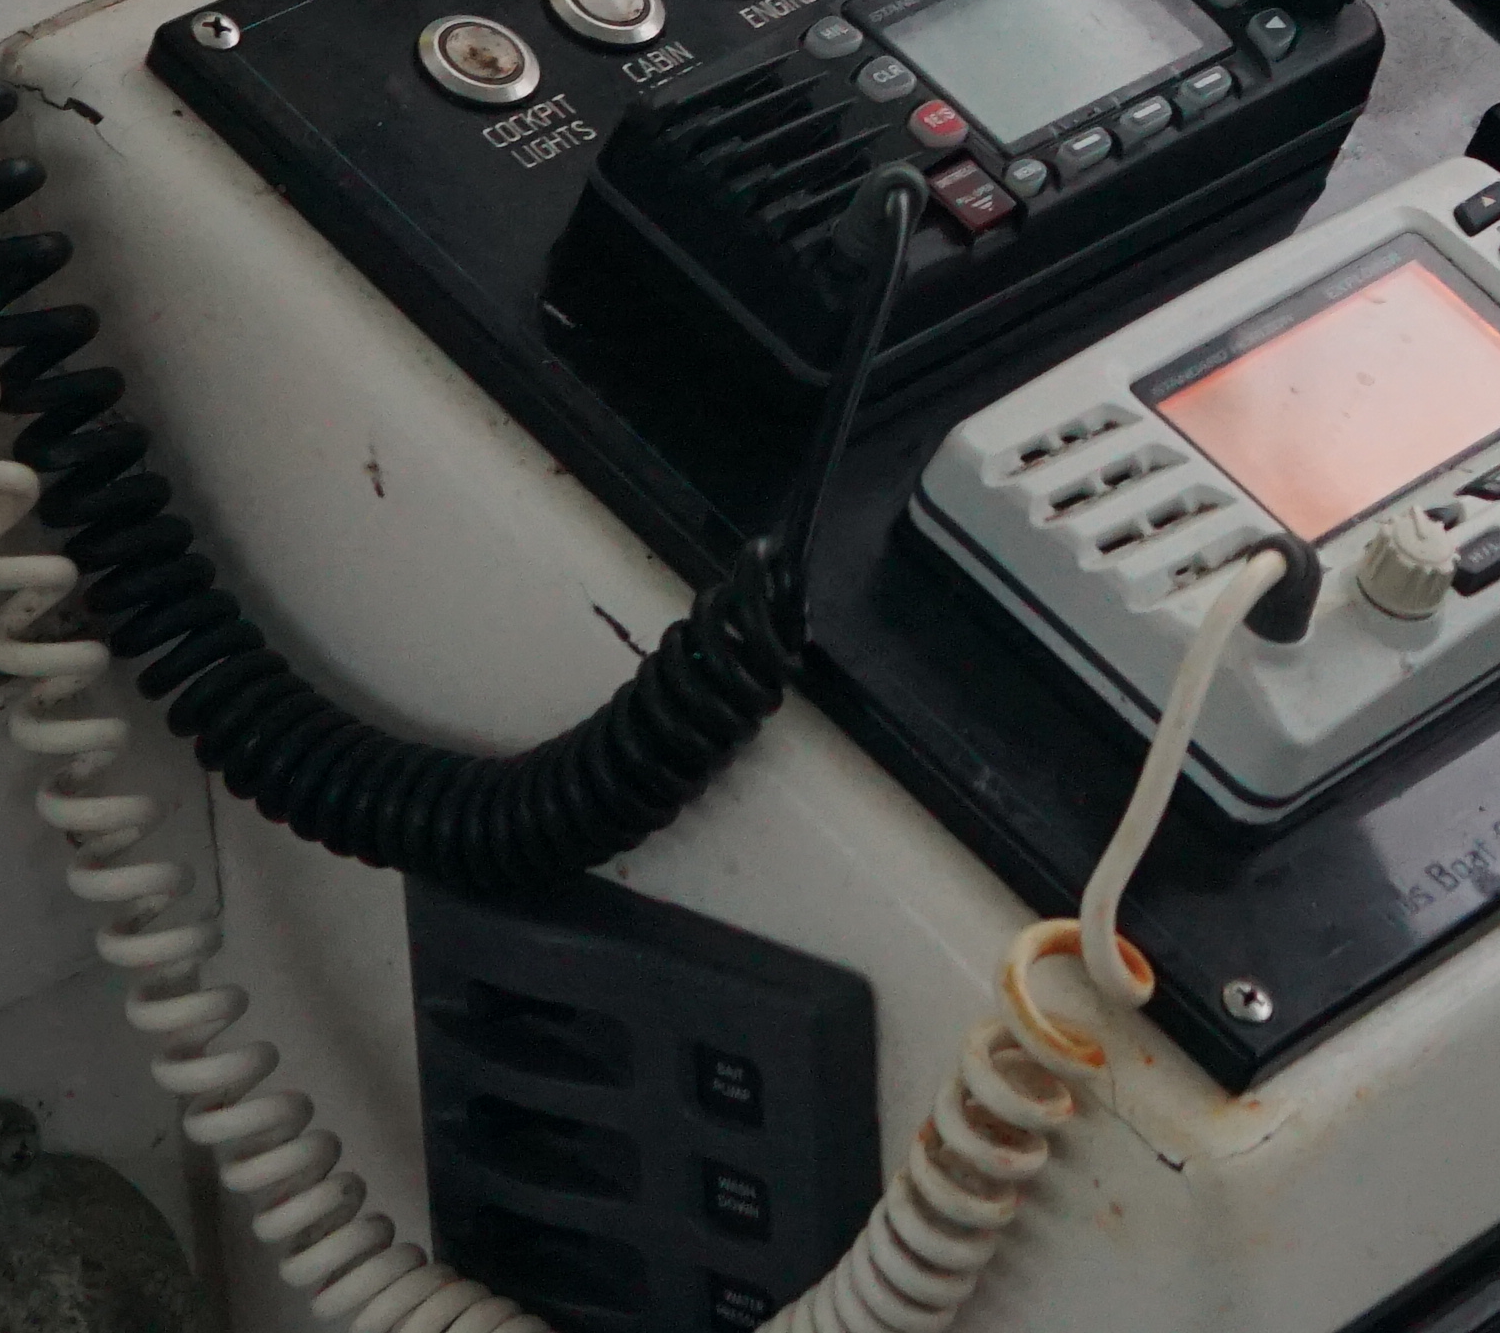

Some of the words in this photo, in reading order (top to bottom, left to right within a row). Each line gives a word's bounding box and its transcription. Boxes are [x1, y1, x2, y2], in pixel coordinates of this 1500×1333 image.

[621, 41, 695, 83] CABIN
[873, 64, 903, 83] CLR
[482, 93, 577, 148] COCKPIT
[511, 120, 598, 168] LIGHTS
[1424, 837, 1497, 892] Boat
